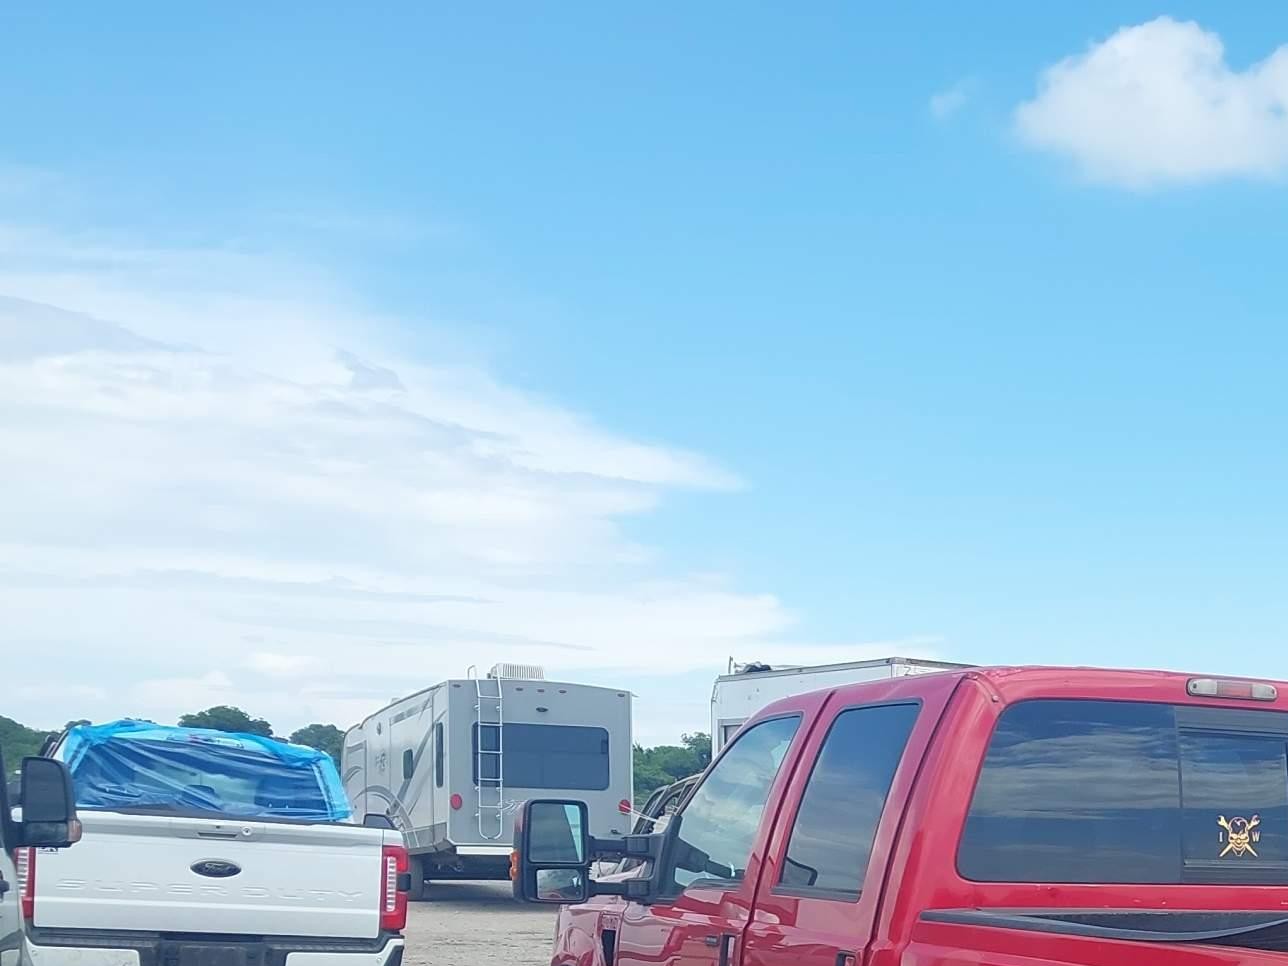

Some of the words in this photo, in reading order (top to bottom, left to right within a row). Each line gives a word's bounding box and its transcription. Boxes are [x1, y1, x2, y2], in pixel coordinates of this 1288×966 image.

[1251, 831, 1260, 842] W
[55, 878, 229, 897] SUPER
[243, 886, 366, 902] DUTY
